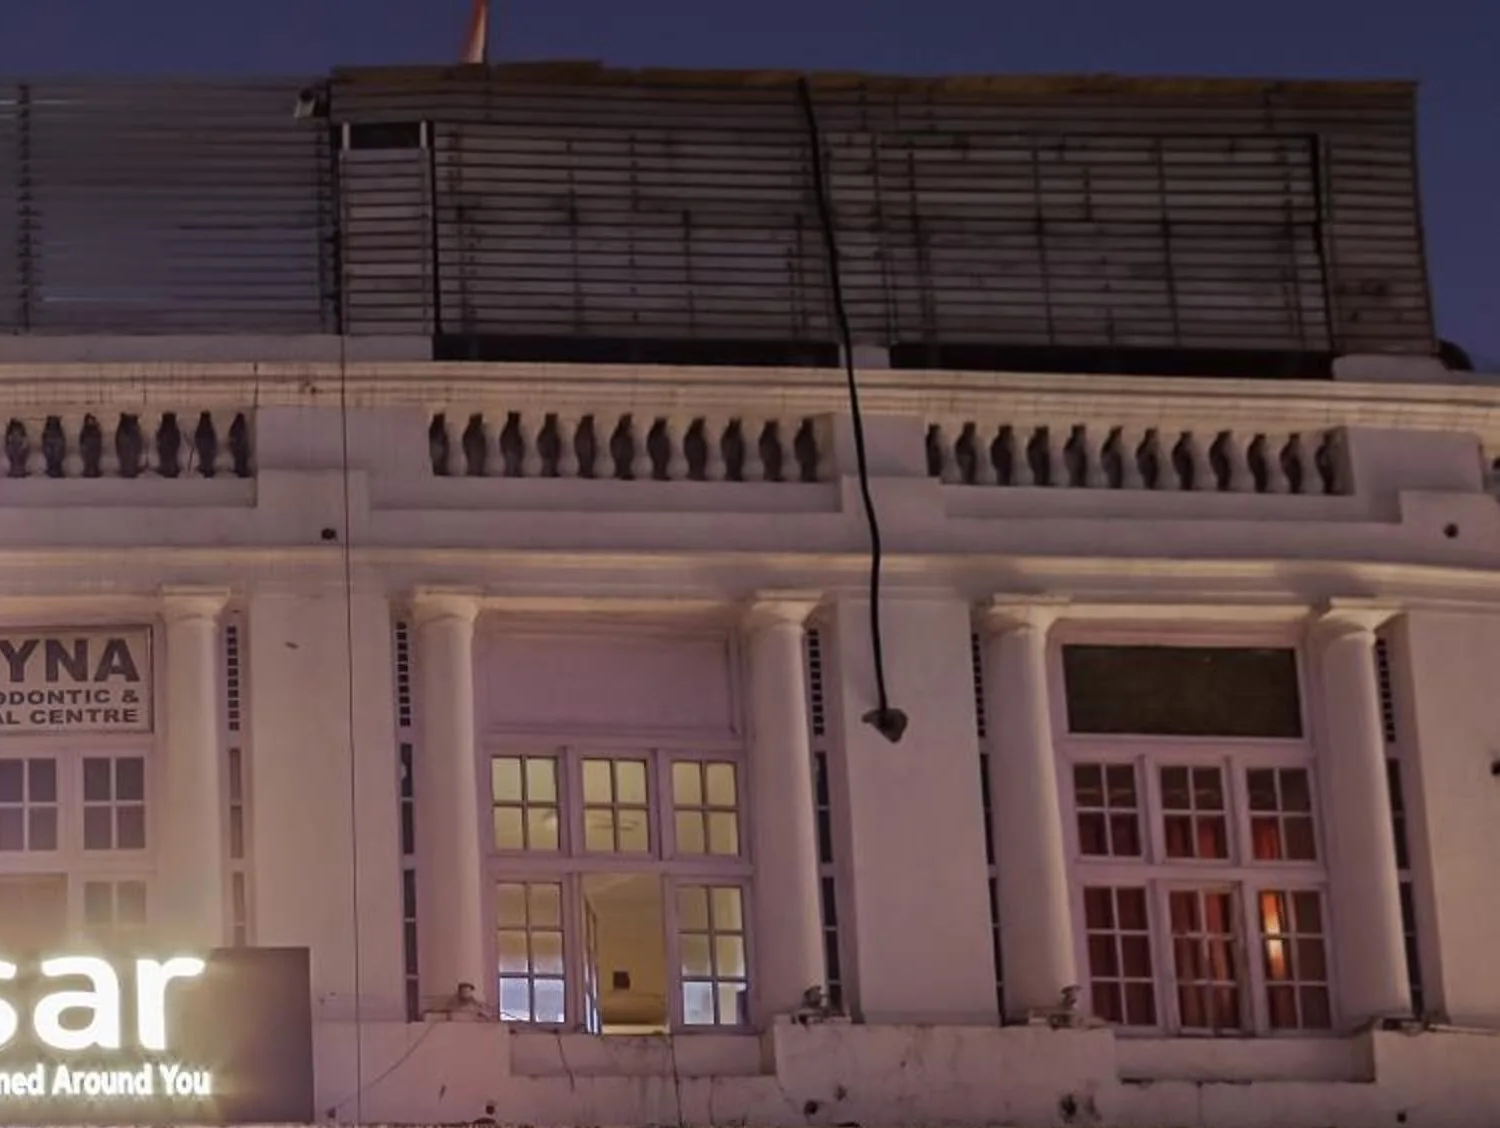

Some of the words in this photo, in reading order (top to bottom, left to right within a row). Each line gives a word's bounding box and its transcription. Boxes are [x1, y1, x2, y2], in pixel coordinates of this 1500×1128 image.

[121, 689, 140, 704] &
[29, 708, 138, 725] CENTRE
[52, 1064, 152, 1096] Around
[160, 1065, 212, 1096] You
